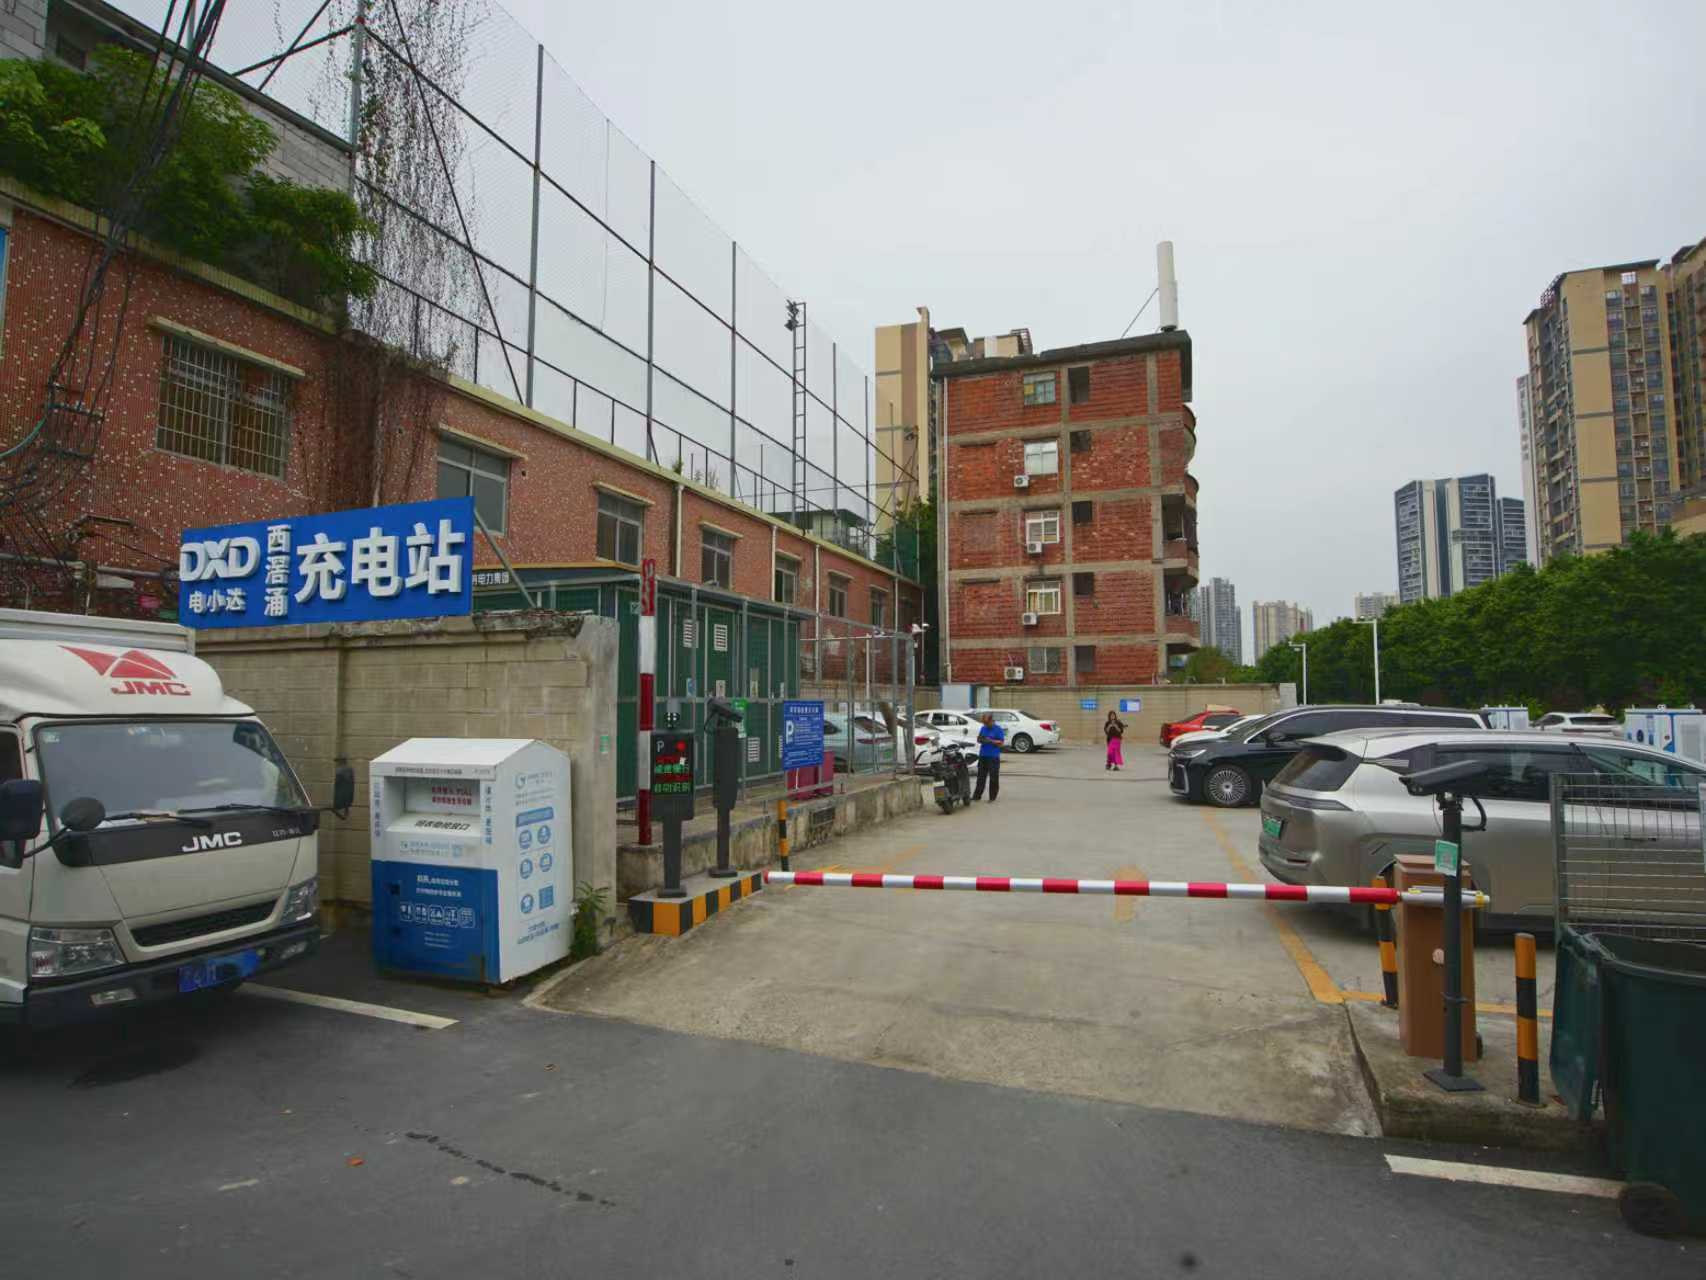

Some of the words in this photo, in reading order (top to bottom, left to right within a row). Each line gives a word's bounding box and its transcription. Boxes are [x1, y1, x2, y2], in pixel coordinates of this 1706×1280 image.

[179, 536, 260, 581] DXD
[264, 524, 291, 617] 西滘涌
[294, 519, 465, 602] 充电站
[188, 588, 247, 615] 电小达
[110, 681, 192, 696] JMC
[785, 720, 795, 744] P
[656, 741, 665, 753] P
[182, 831, 244, 853] JMC
